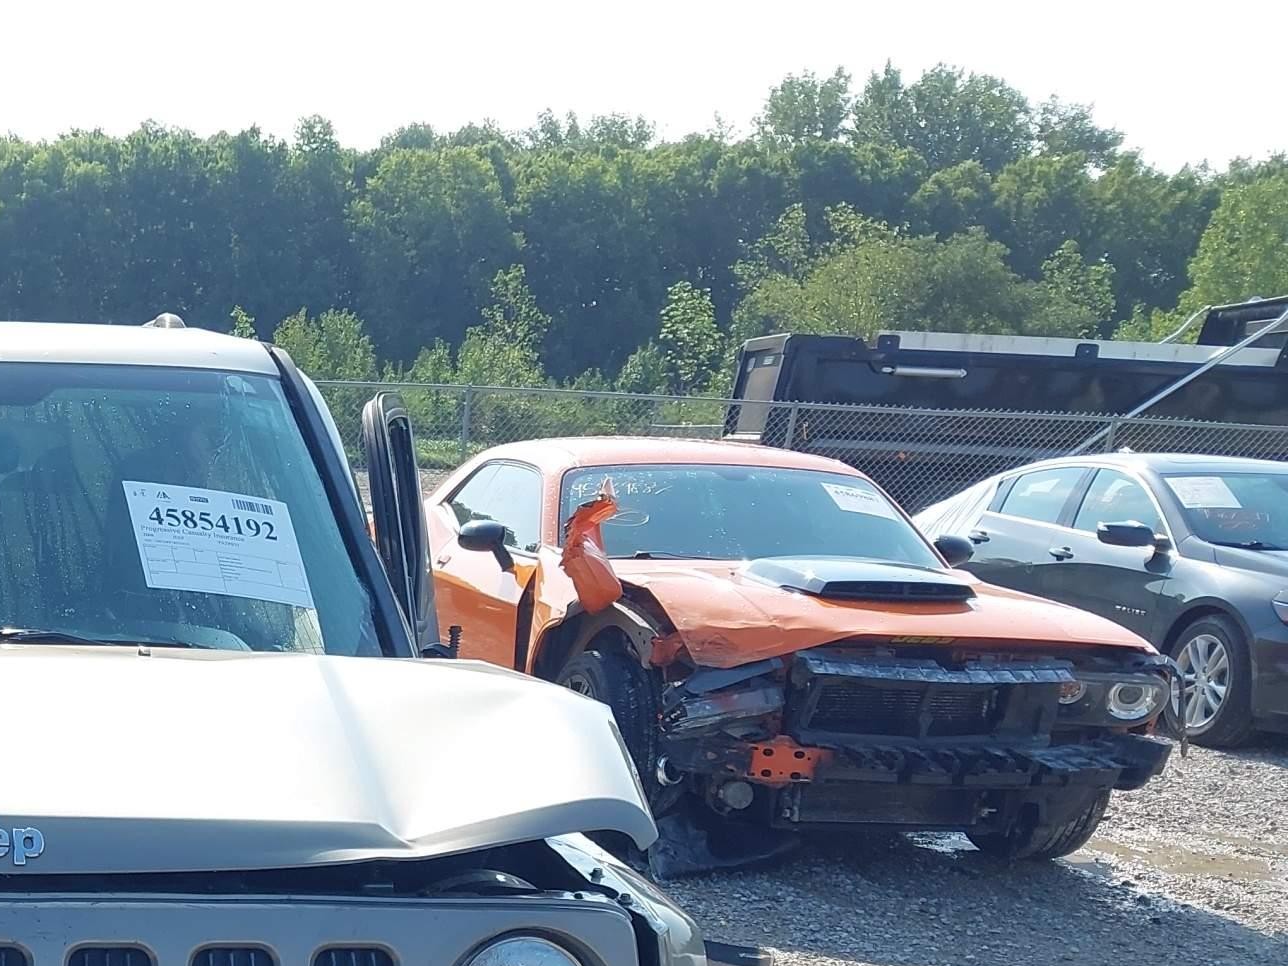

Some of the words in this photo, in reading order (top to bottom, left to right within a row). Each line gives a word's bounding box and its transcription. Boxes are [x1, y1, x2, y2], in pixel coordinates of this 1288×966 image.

[141, 525, 181, 535] Progressive
[182, 528, 211, 539] Casualty
[213, 532, 245, 542] Insurance
[149, 507, 278, 541] 45854192
